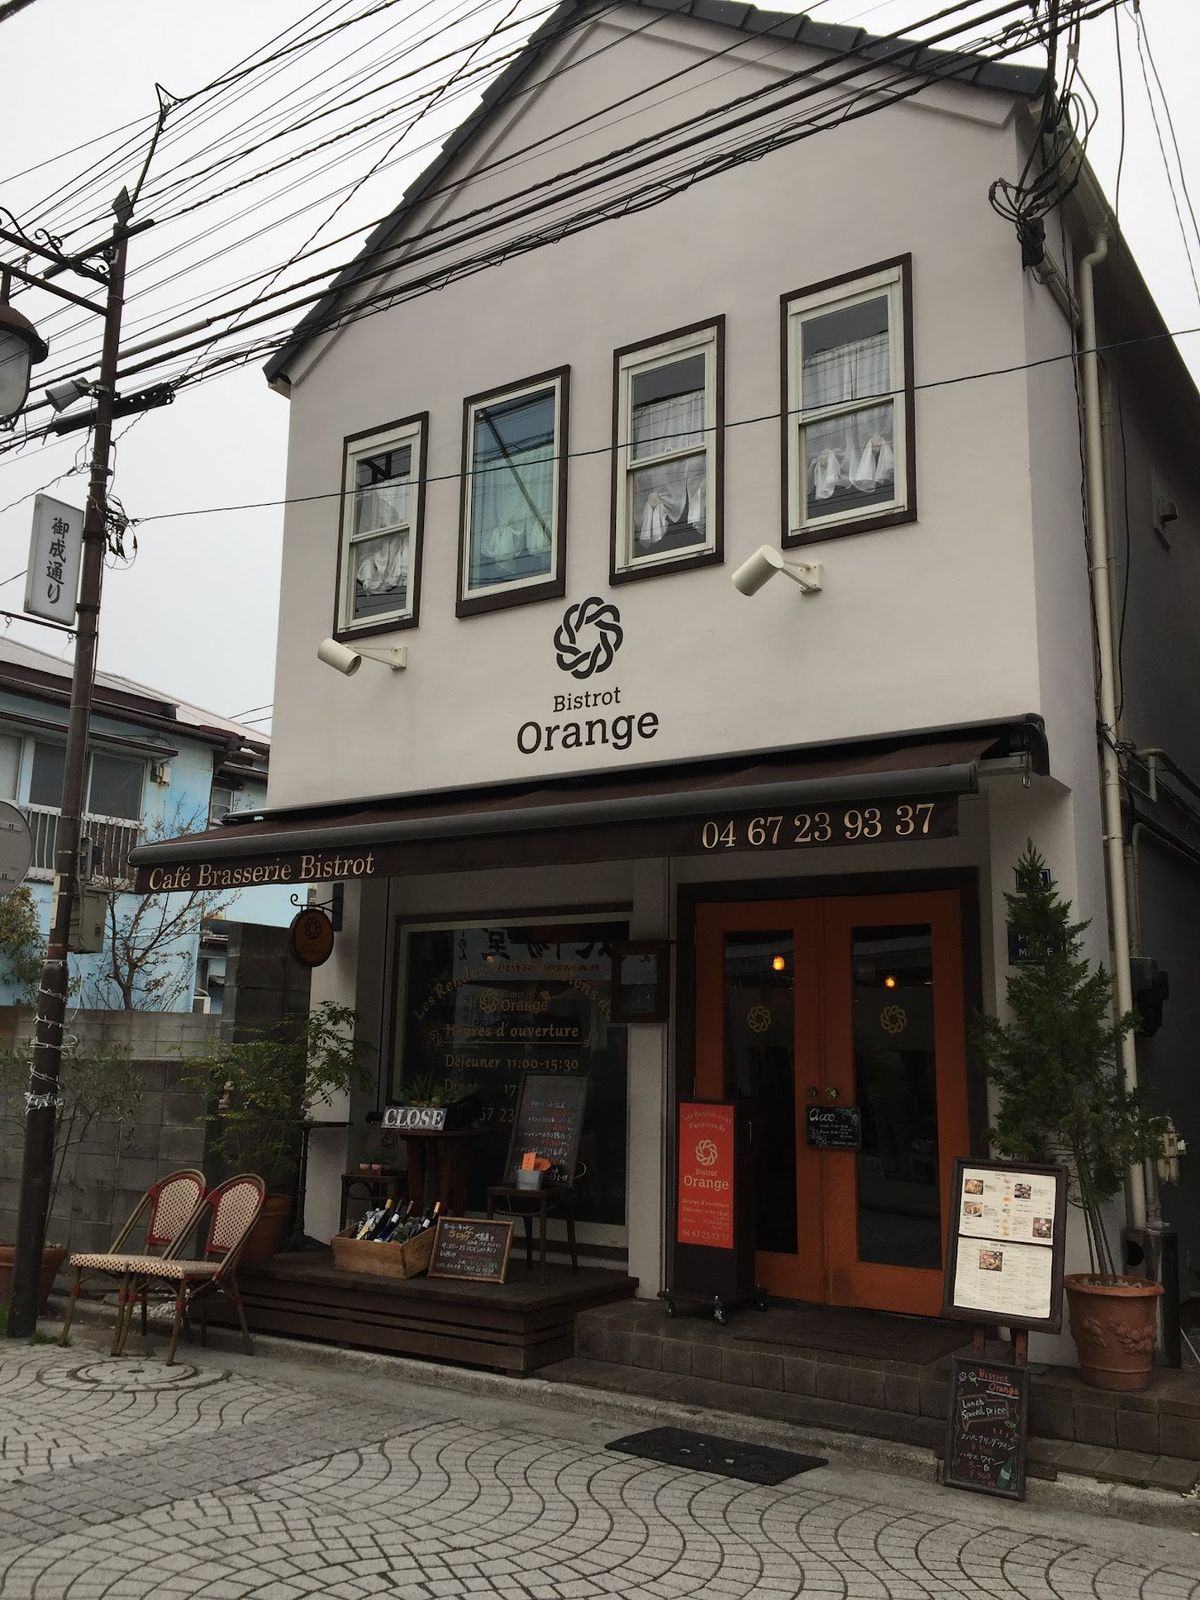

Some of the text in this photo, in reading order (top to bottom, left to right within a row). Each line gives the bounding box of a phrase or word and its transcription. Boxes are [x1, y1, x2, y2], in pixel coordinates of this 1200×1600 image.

[46, 516, 70, 604] 御成通り
[553, 686, 621, 713] Bistrot
[517, 711, 659, 755] Orange
[701, 802, 935, 849] 04 67 23 93 37
[148, 851, 375, 891] Café Brasserie Bistrot
[501, 998, 549, 1014] Orange
[384, 1108, 443, 1127] CLOSE
[683, 1174, 729, 1192] Orange
